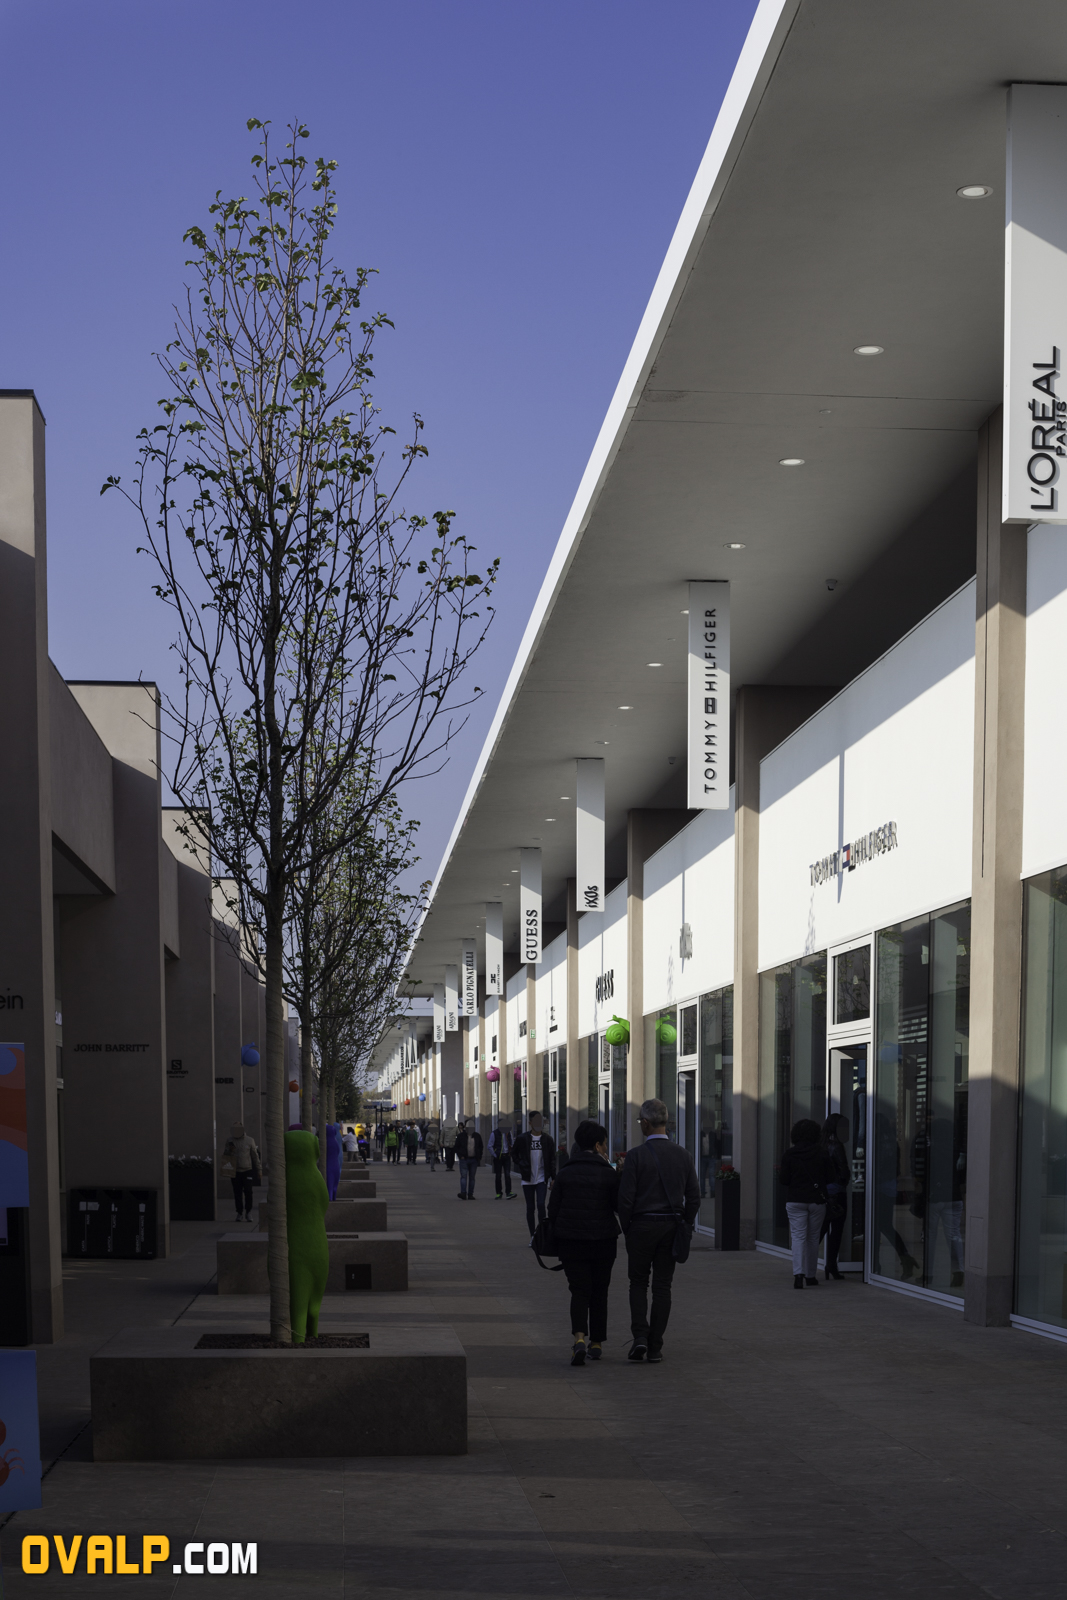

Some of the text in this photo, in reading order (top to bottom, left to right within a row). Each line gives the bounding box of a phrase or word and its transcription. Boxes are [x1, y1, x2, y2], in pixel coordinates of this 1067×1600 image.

[1027, 345, 1058, 510] L'ORÉAL
[1056, 401, 1067, 456] PARIS
[704, 608, 717, 794] TOMMY HILFIGER
[526, 909, 538, 961] GUESS
[465, 951, 475, 1015] CARLO PIGNATELLI
[74, 1044, 149, 1052] JOHN BARRITT
